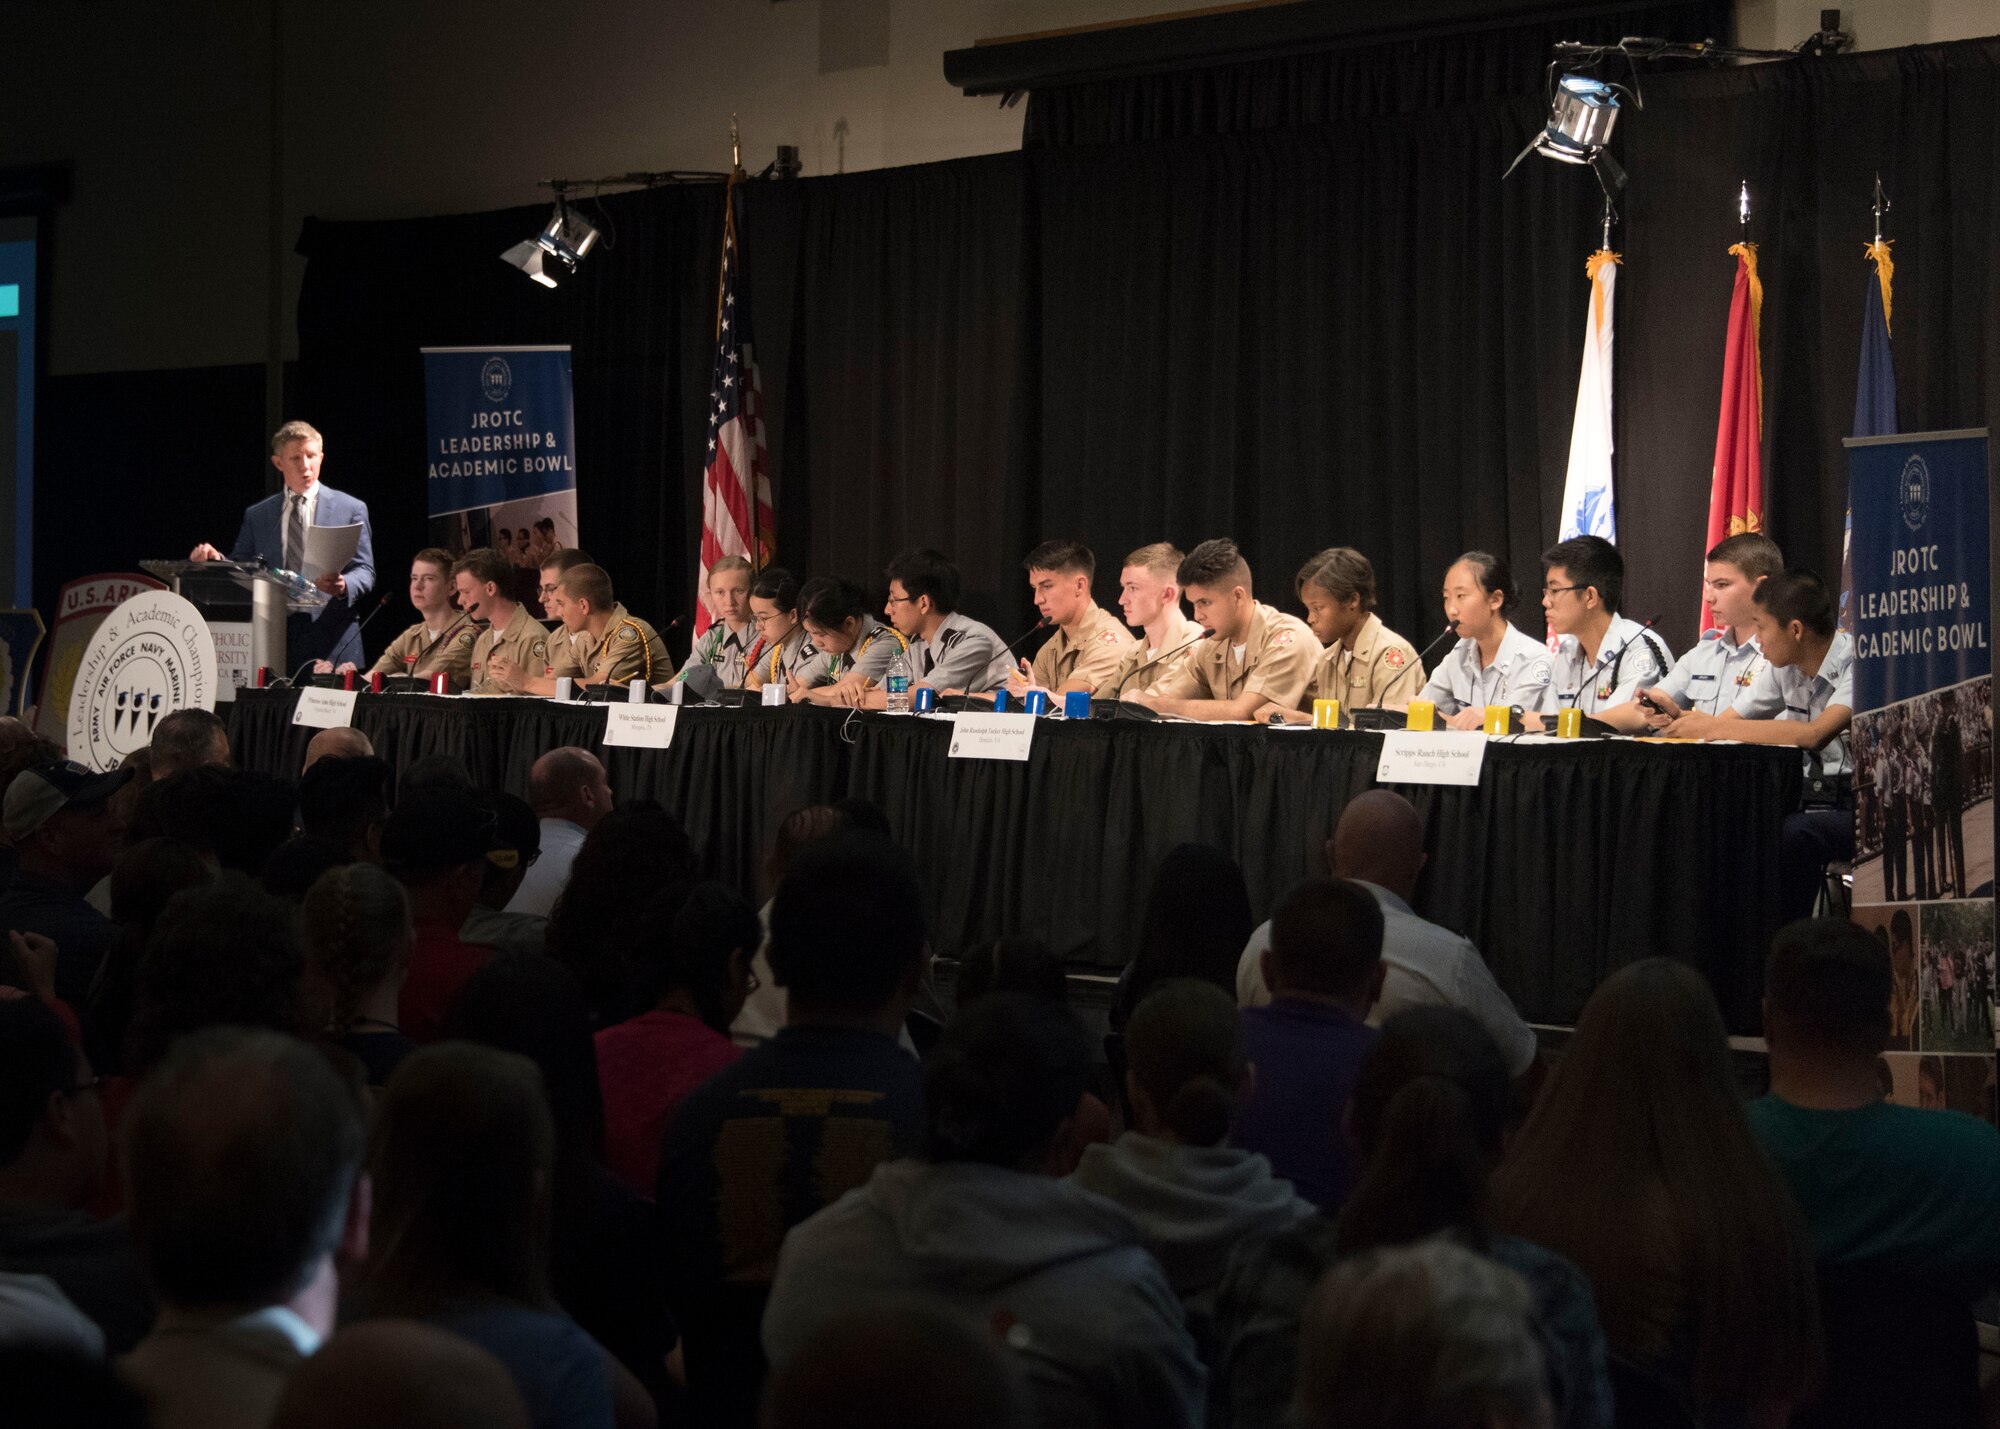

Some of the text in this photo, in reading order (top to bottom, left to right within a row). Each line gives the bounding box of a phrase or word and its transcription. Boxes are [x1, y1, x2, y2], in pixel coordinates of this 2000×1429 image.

[471, 410, 523, 429] JROTC
[440, 432, 556, 455] LEADERSHIP &
[428, 455, 573, 479] ACADEMIC BOWL
[1890, 544, 1939, 576] JROTC
[1859, 581, 1970, 619] LEADERSHIP &
[108, 626, 121, 642] &
[126, 603, 181, 630] Academic
[1937, 622, 1987, 652] BOWL
[92, 642, 180, 743] ARMY AIR FORCE NAVY MARINE
[1001, 728, 1011, 736] High
[1011, 728, 1025, 736] School
[1395, 749, 1469, 759] Scripps Ranch High School
